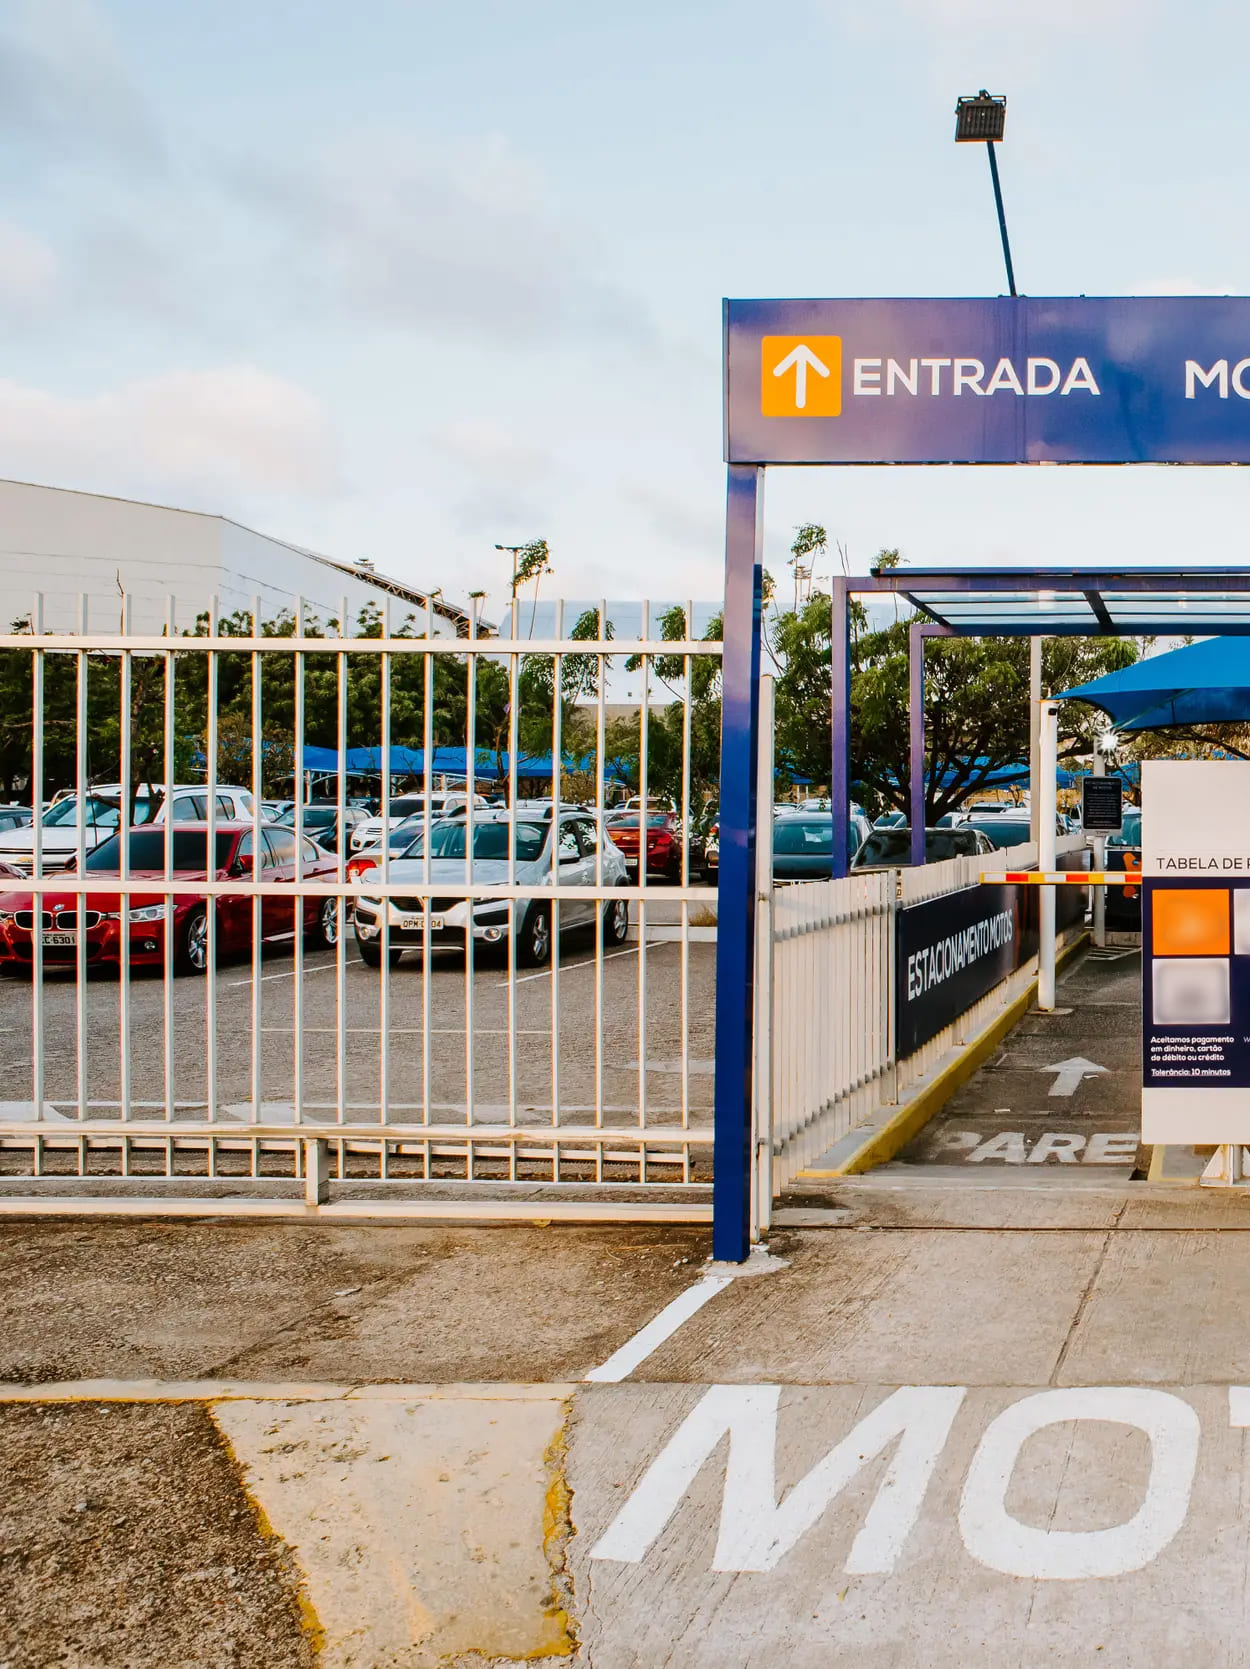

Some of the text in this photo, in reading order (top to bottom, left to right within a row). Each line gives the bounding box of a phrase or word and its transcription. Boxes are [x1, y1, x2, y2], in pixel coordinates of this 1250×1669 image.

[853, 357, 1100, 396] ENTRADA
[1156, 857, 1219, 870] TABELA
[1222, 857, 1243, 870] DE
[908, 908, 1013, 1001] ESTACIONAMENTO MOTOS
[1151, 1036, 1235, 1045] Aceitamos pagamento
[1163, 1045, 1197, 1053] dinheiro,
[1162, 1053, 1186, 1061] débito
[1197, 1053, 1225, 1061] crédito
[1151, 1068, 1231, 1077] Tolerância: 10 minutos
[929, 1131, 1140, 1163] PARE
